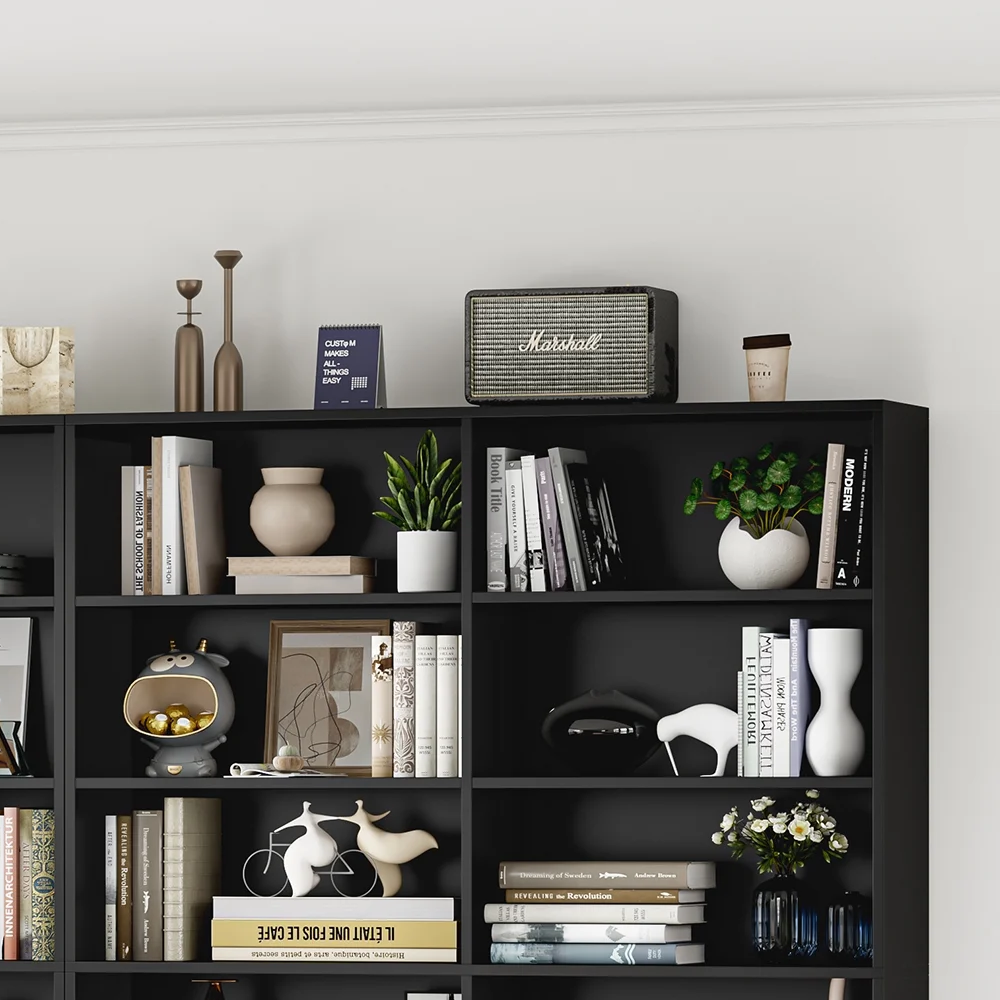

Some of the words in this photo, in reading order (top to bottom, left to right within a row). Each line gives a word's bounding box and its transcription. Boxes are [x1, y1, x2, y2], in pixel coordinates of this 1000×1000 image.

[519, 329, 602, 353] Marshall
[323, 368, 350, 376] THINGS
[490, 454, 504, 484] Book
[842, 458, 855, 512] MODERN
[490, 488, 504, 513] Title
[837, 568, 846, 579] A
[141, 827, 150, 855] Dreaming
[4, 816, 13, 938] INNENARCHITEKTUR
[142, 863, 150, 886] Sweden
[519, 871, 554, 882] Dreaming
[556, 871, 563, 880] of
[565, 872, 592, 880] Sweden
[634, 872, 656, 880] Andrew
[658, 872, 677, 880] Brown
[121, 867, 129, 905] Revolution
[567, 892, 612, 900] Revolution
[257, 925, 284, 944] CAFÉ
[287, 925, 300, 941] LE
[302, 925, 325, 941] FOIS
[329, 926, 350, 941] UNE
[353, 926, 382, 944] ÉTAIT
[385, 926, 395, 941] IL
